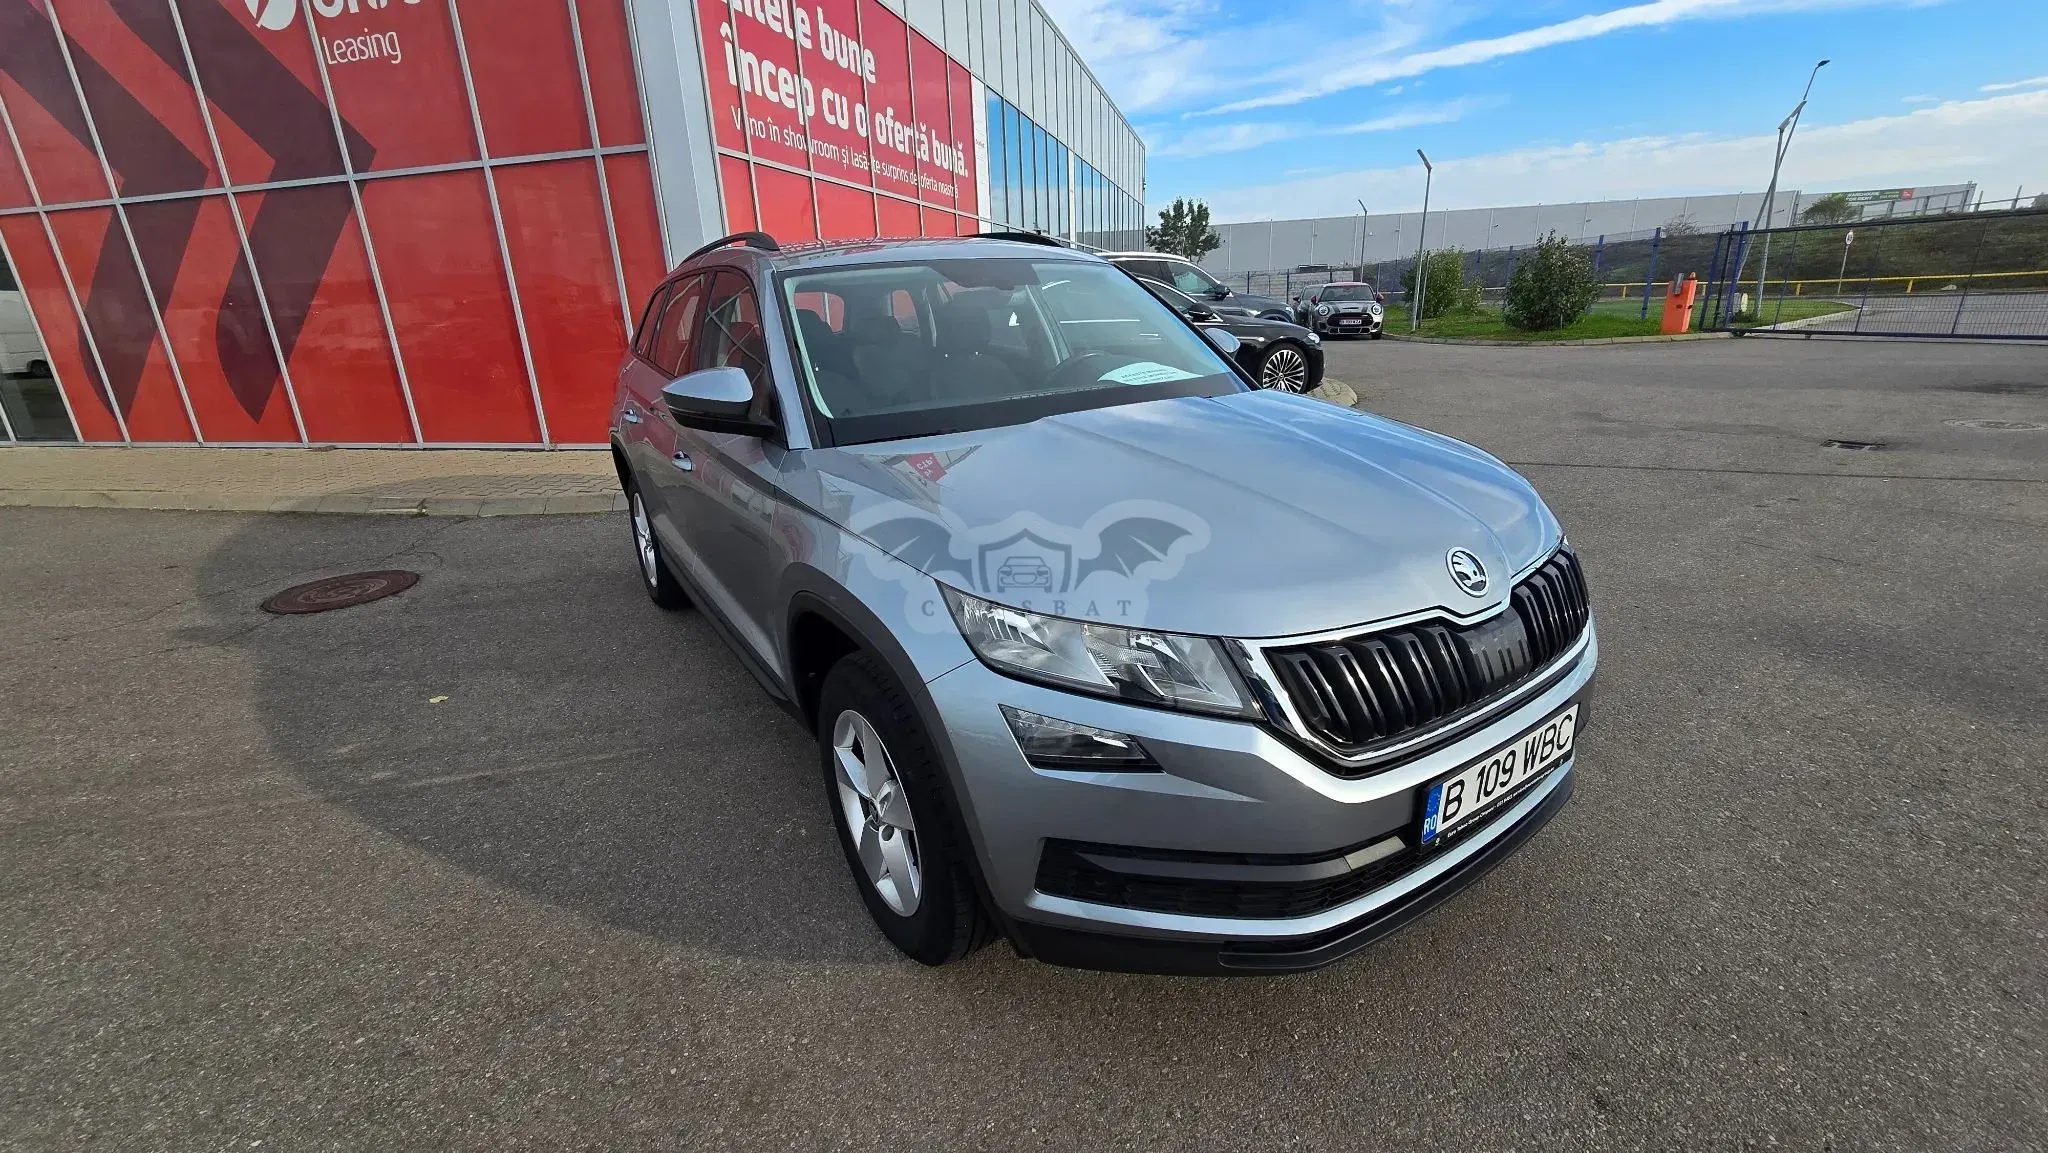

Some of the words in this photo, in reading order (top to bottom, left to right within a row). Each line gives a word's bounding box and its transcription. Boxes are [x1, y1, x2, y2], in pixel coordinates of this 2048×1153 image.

[322, 28, 402, 65] Leasing
[816, 6, 877, 83] bune
[720, 22, 815, 125] încep
[821, 87, 849, 130] cu
[854, 102, 868, 138] o
[875, 106, 929, 162] ofertă
[730, 104, 766, 139] Vno
[766, 116, 781, 144] în
[909, 168, 918, 186] de
[1441, 778, 1466, 825] B
[1475, 749, 1517, 804] 109
[1522, 714, 1572, 776] WBC
[1423, 815, 1437, 836] RO
